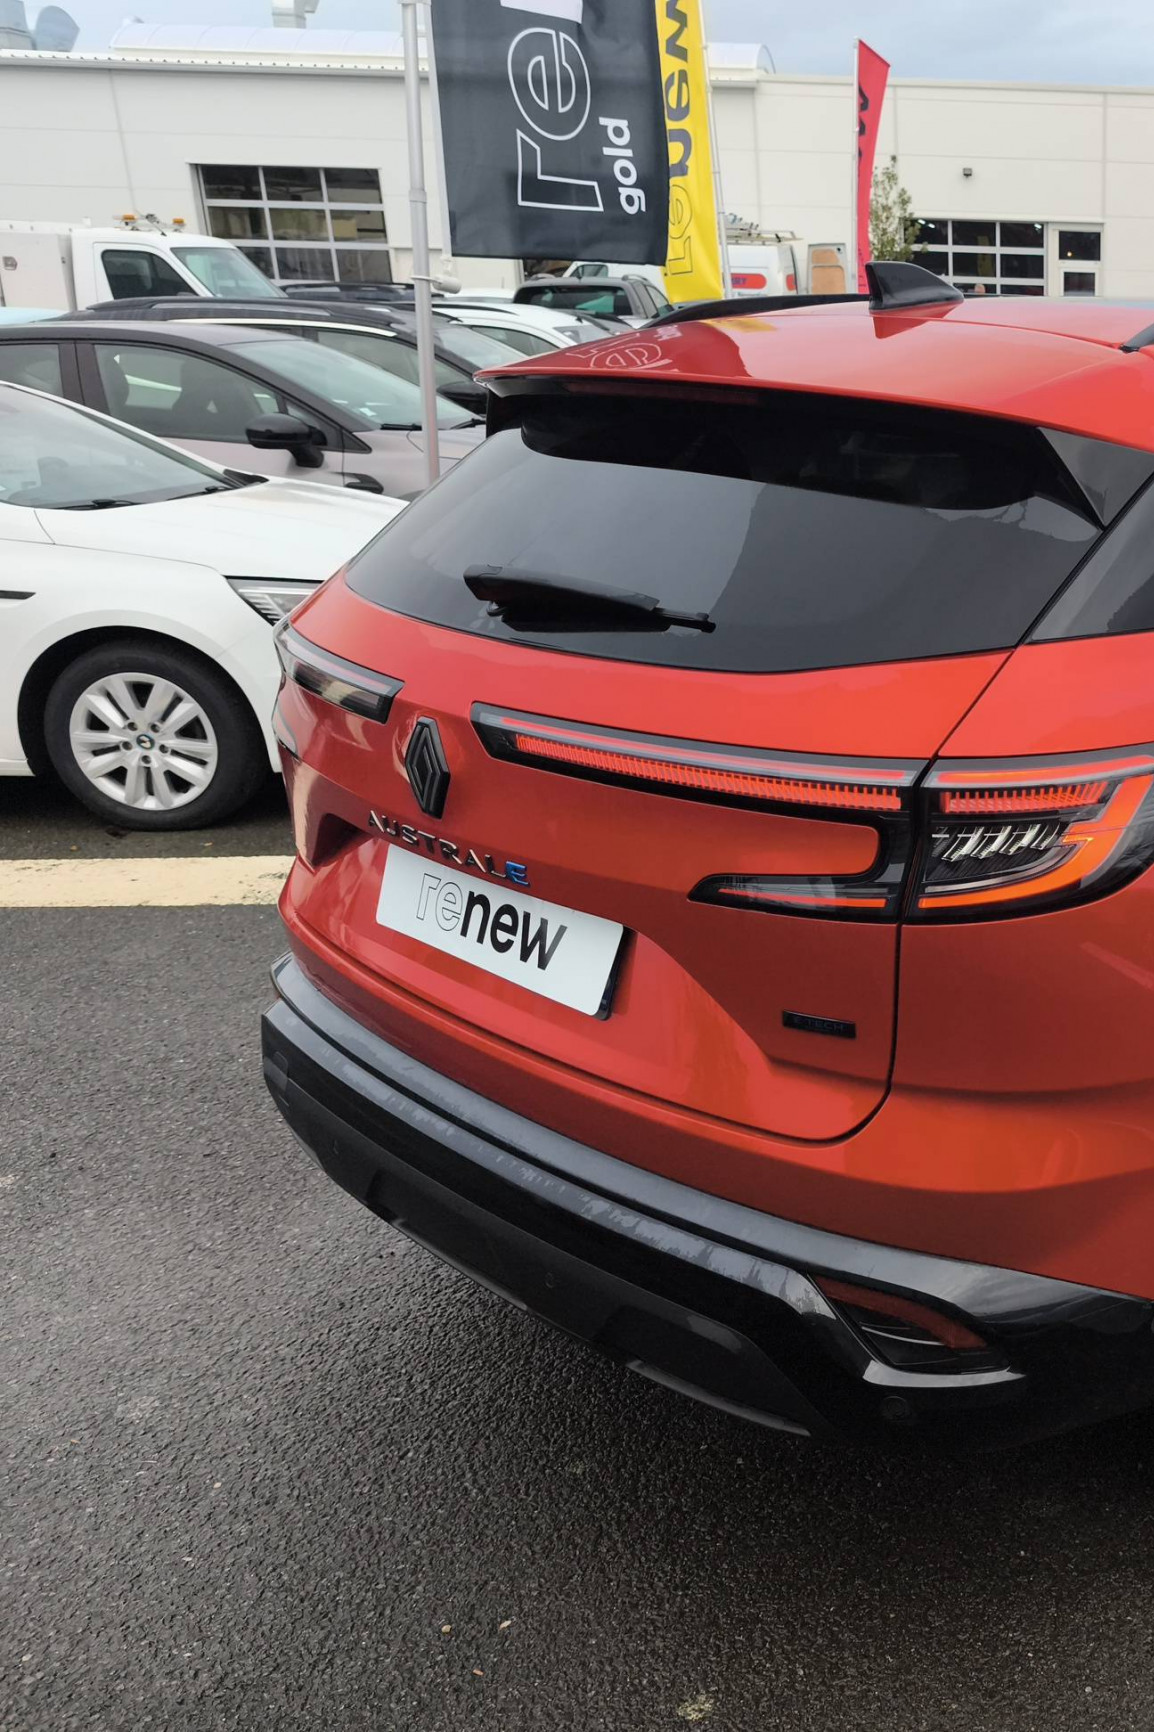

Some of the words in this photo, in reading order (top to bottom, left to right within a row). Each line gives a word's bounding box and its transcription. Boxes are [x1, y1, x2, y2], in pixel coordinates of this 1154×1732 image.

[500, 0, 604, 212] re
[599, 116, 646, 215] gold
[416, 872, 568, 971] renew
